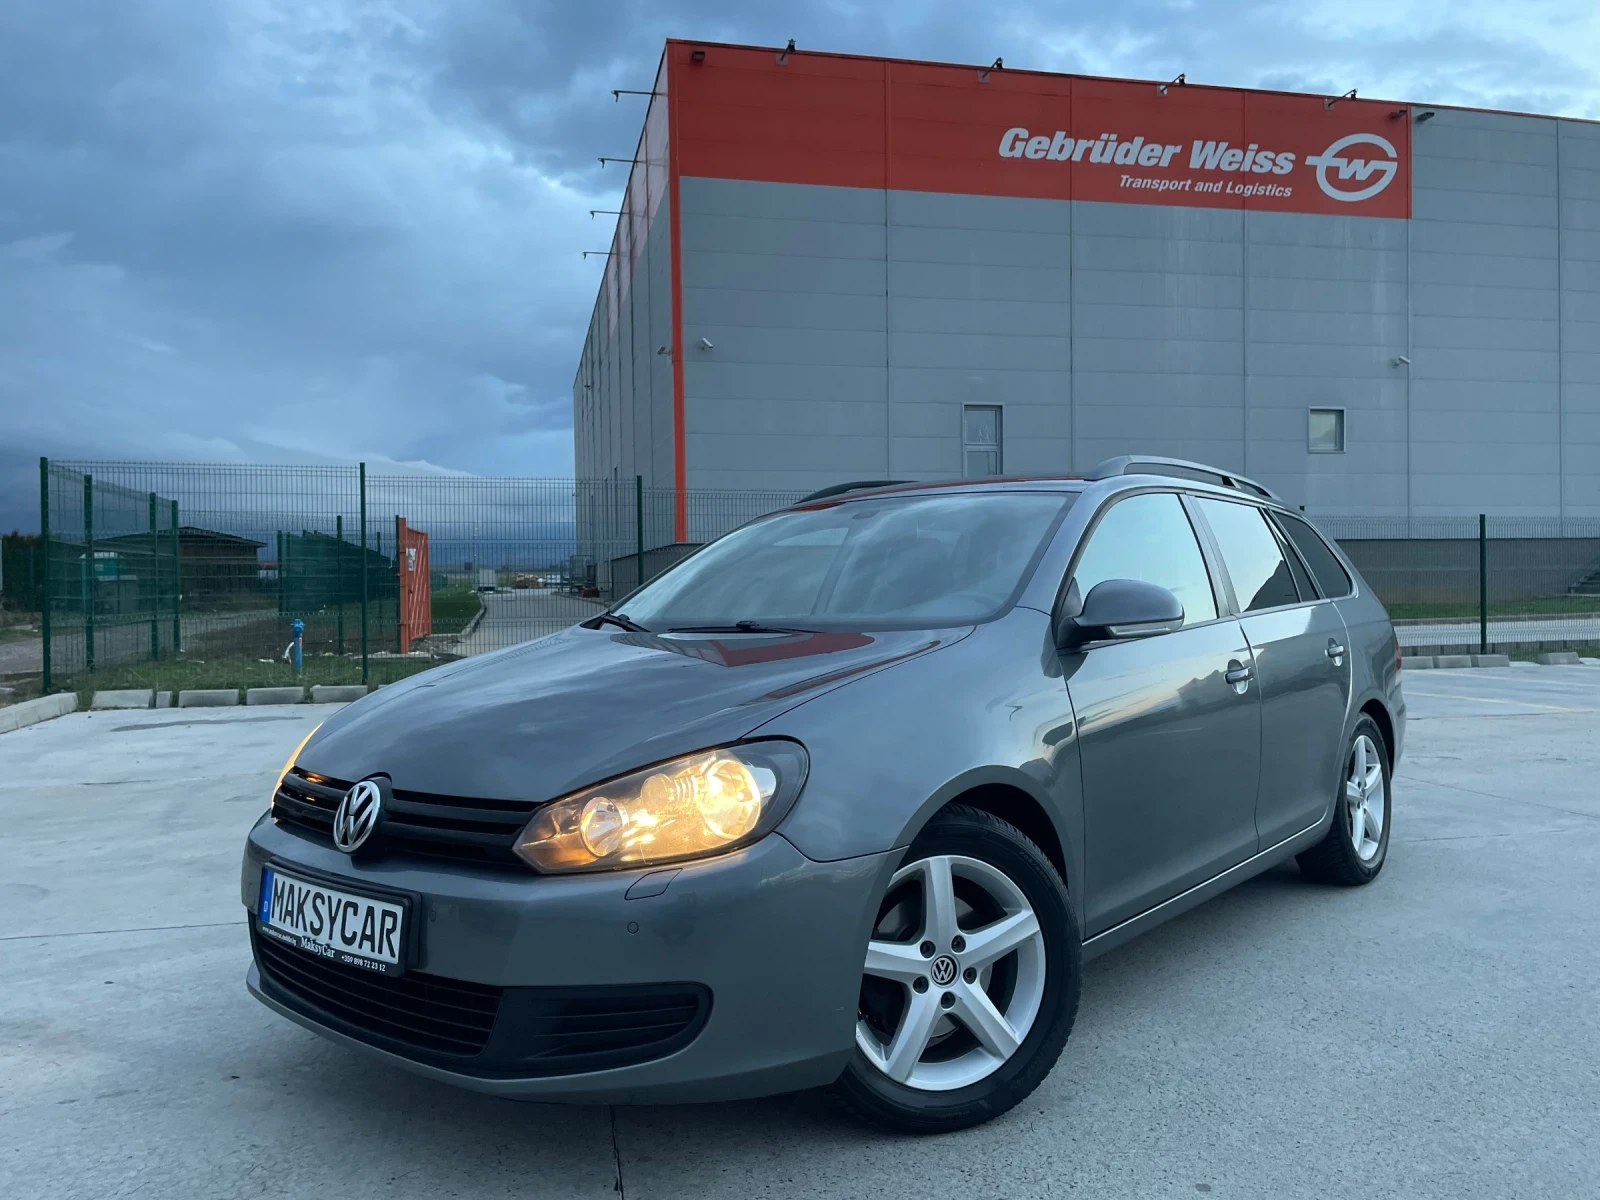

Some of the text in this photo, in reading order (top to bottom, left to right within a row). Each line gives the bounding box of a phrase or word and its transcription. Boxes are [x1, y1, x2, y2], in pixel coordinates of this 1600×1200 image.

[998, 127, 1296, 175] Gebrüder Weiss
[1120, 174, 1292, 198] Transport and Logistics
[271, 877, 398, 959] MAKSYCAR
[300, 938, 336, 958] MaksyCar
[363, 959, 371, 968] 72
[371, 961, 379, 970] 23
[379, 963, 386, 972] 12
